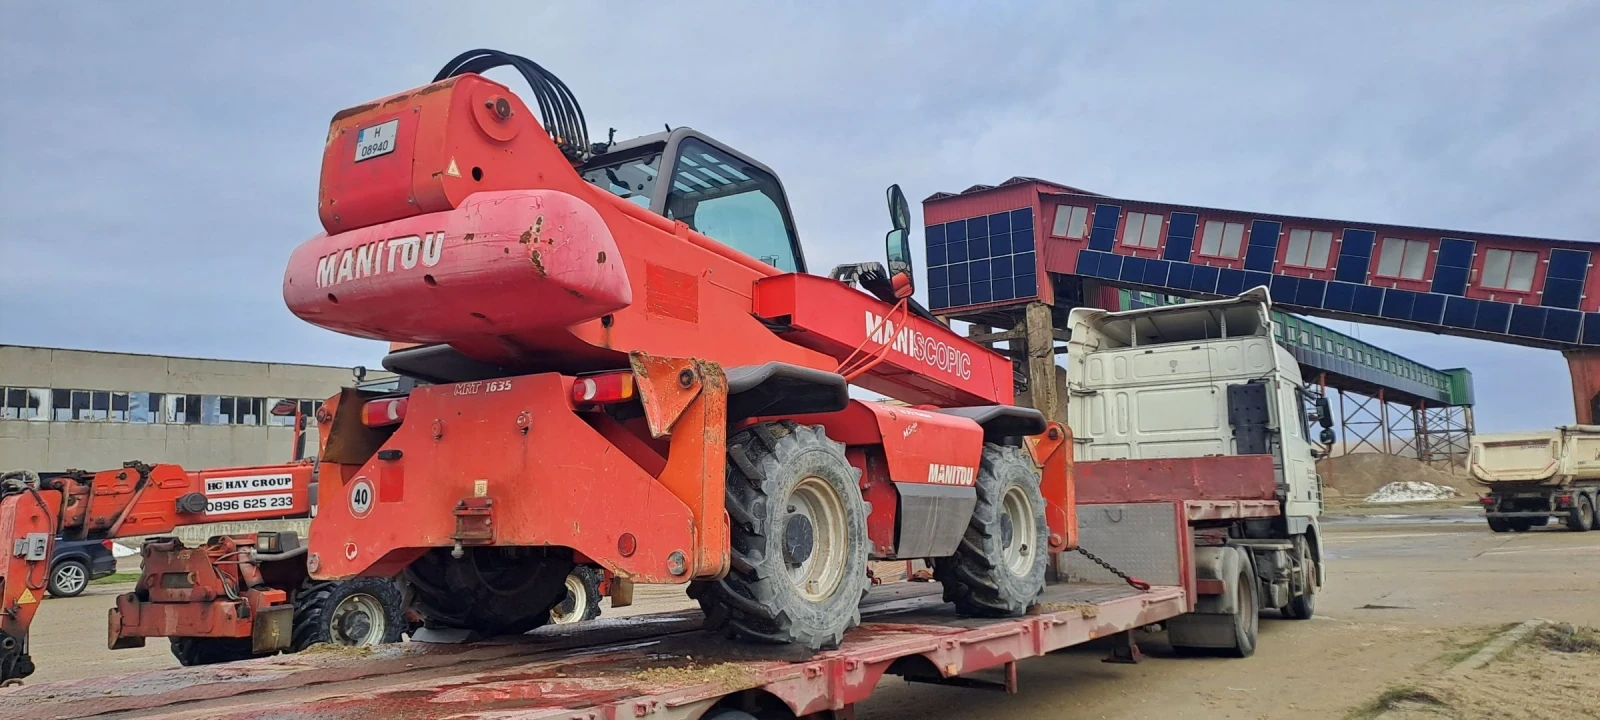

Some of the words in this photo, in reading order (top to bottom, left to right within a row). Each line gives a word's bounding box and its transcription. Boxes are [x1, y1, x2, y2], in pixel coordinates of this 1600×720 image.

[374, 126, 382, 138] H
[361, 140, 389, 157] 08940
[317, 231, 445, 288] MANITOU
[865, 310, 971, 380] MANISCOPIC
[453, 381, 482, 396] MRT
[485, 379, 512, 393] 1635
[929, 463, 973, 485] MANITOU
[207, 482, 223, 491] HG
[225, 480, 249, 489] HAY
[252, 477, 292, 488] GROUP
[205, 500, 240, 512] 0896
[243, 498, 267, 509] 625
[270, 496, 293, 507] 233
[354, 488, 368, 505] 40
